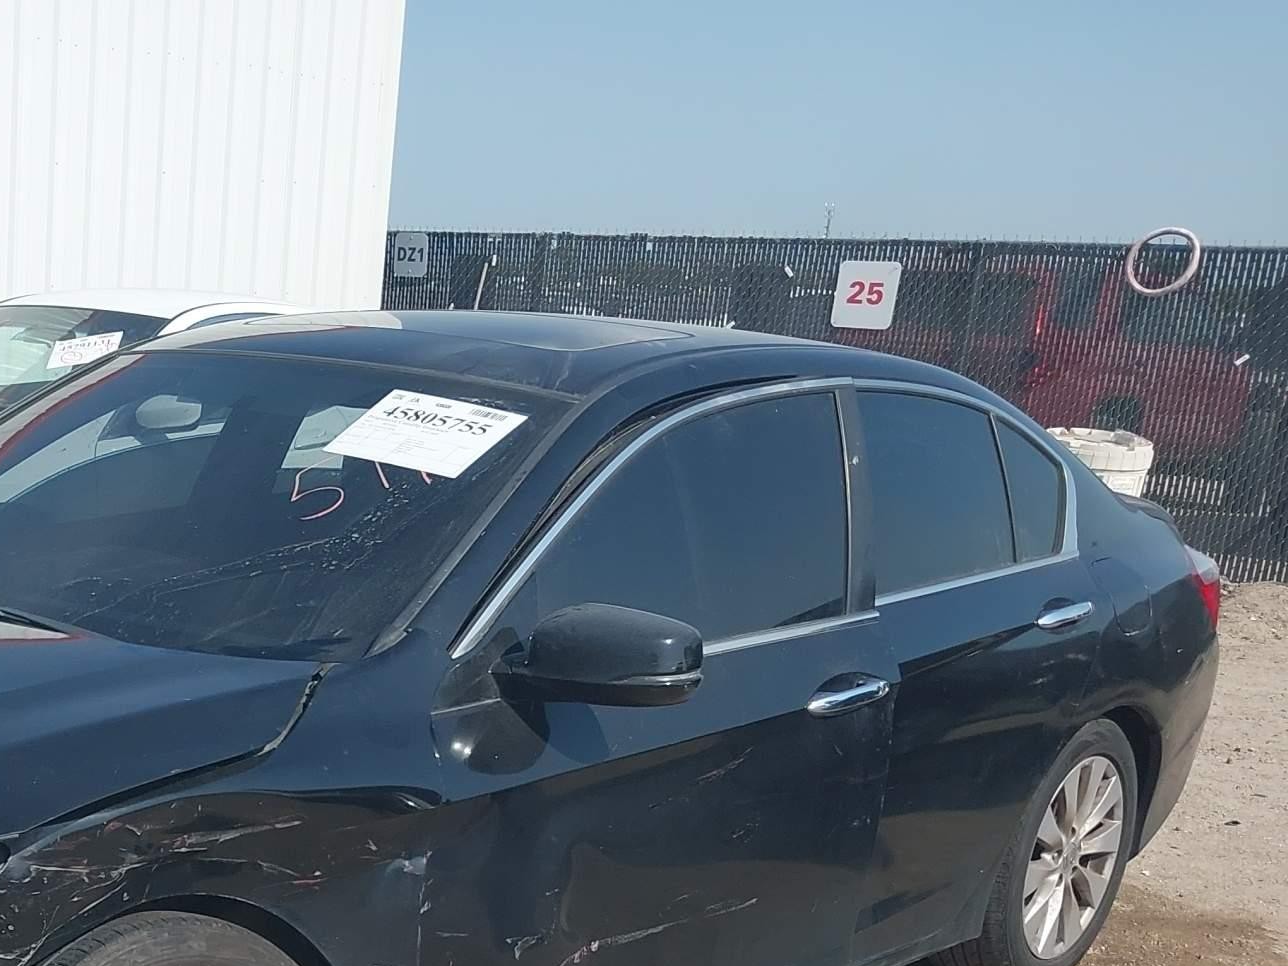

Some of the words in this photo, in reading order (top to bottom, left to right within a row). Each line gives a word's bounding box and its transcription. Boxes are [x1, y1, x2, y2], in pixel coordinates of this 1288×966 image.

[397, 246, 424, 262] DZ1
[846, 281, 884, 305] 25
[383, 406, 493, 435] 45805755
